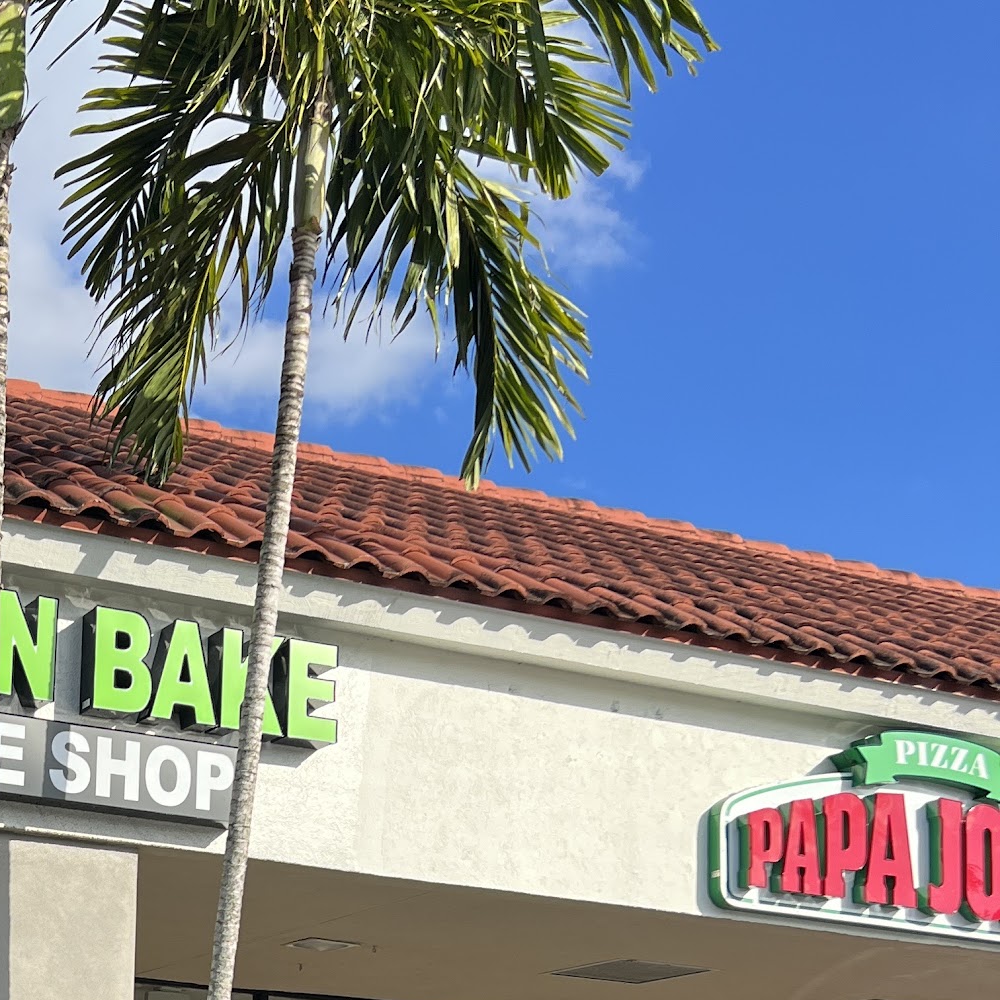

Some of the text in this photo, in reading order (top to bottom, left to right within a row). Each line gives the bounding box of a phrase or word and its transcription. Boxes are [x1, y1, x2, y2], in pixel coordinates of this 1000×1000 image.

[92, 605, 339, 744] BAKE
[48, 730, 236, 812] SHOP
[894, 739, 990, 780] PIZZA
[747, 792, 917, 909] PAPA
